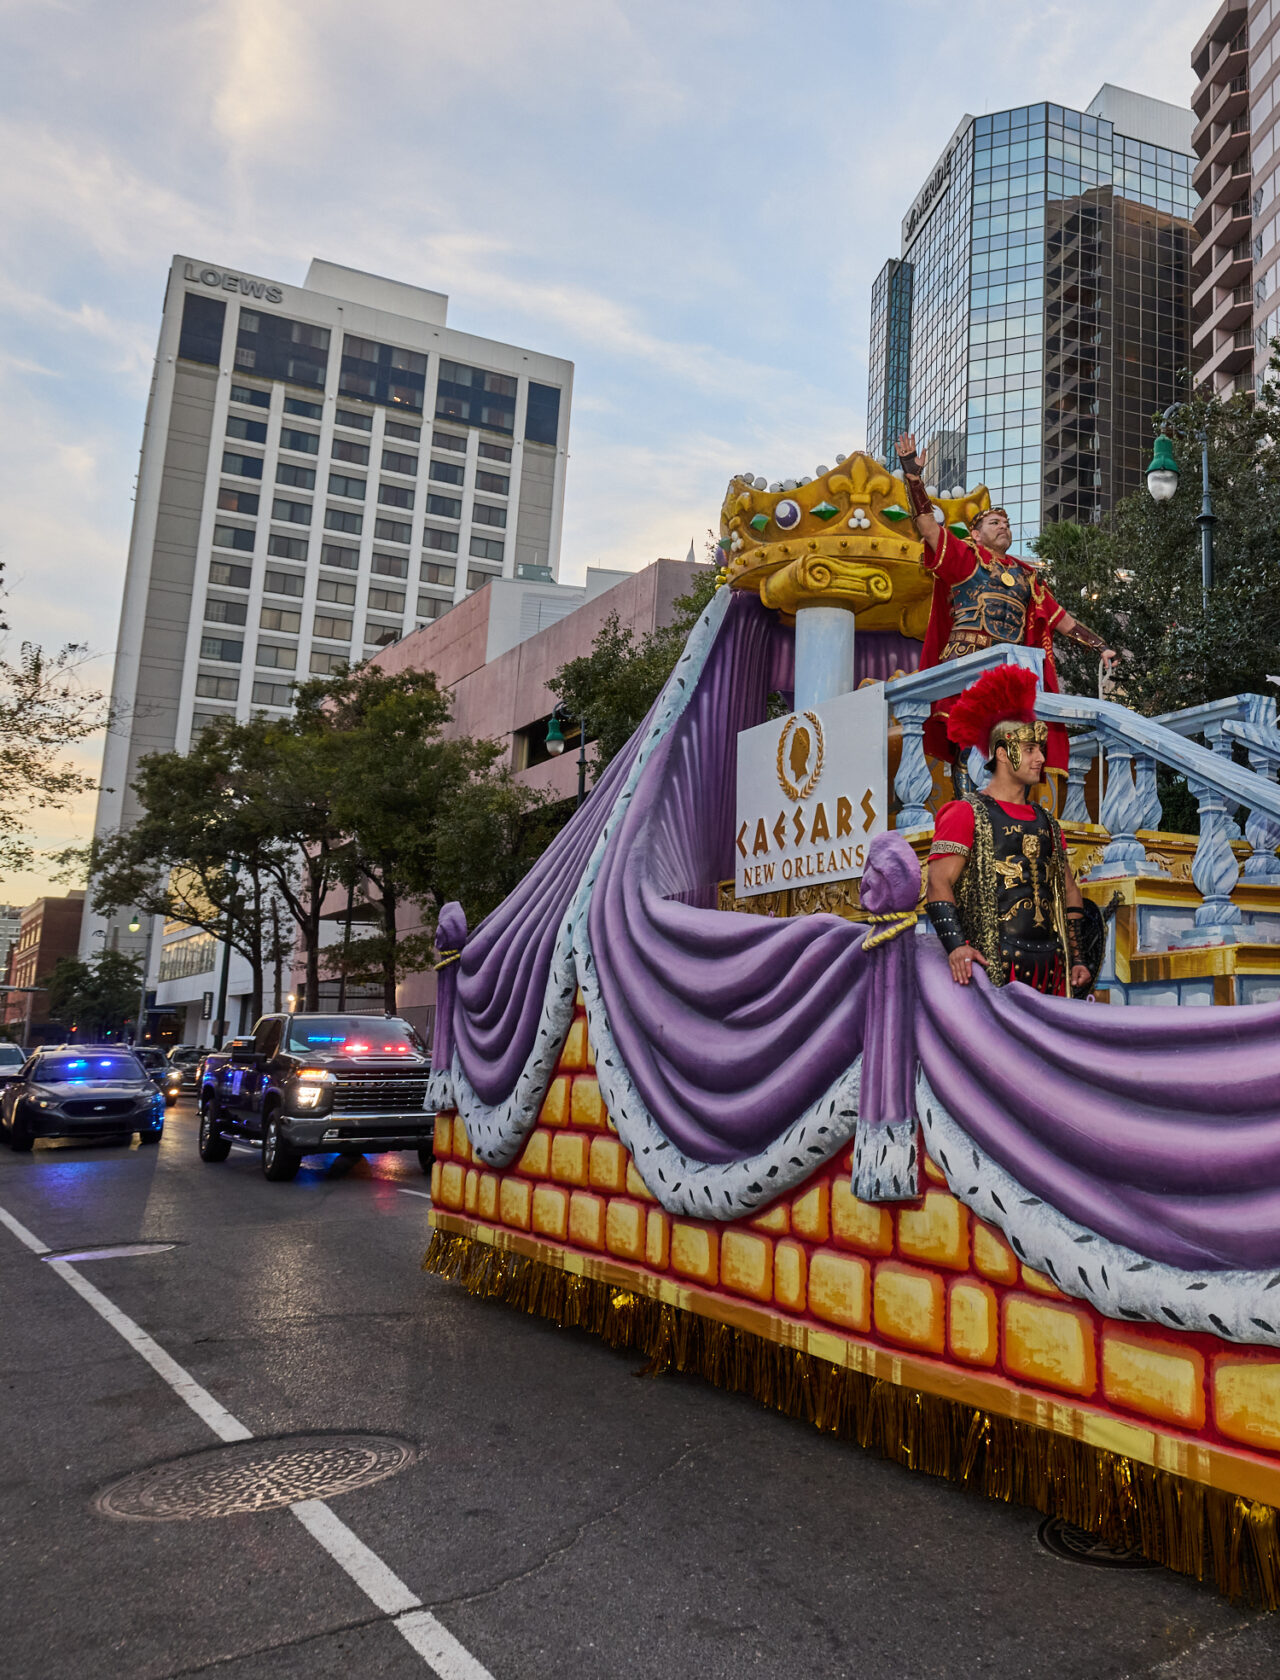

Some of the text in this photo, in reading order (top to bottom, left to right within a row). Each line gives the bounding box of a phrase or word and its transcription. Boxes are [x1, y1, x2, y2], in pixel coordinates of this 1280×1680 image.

[184, 263, 283, 303] LOEWS
[737, 788, 876, 858] CAESARS
[744, 844, 865, 888] NEW ORLEANS
